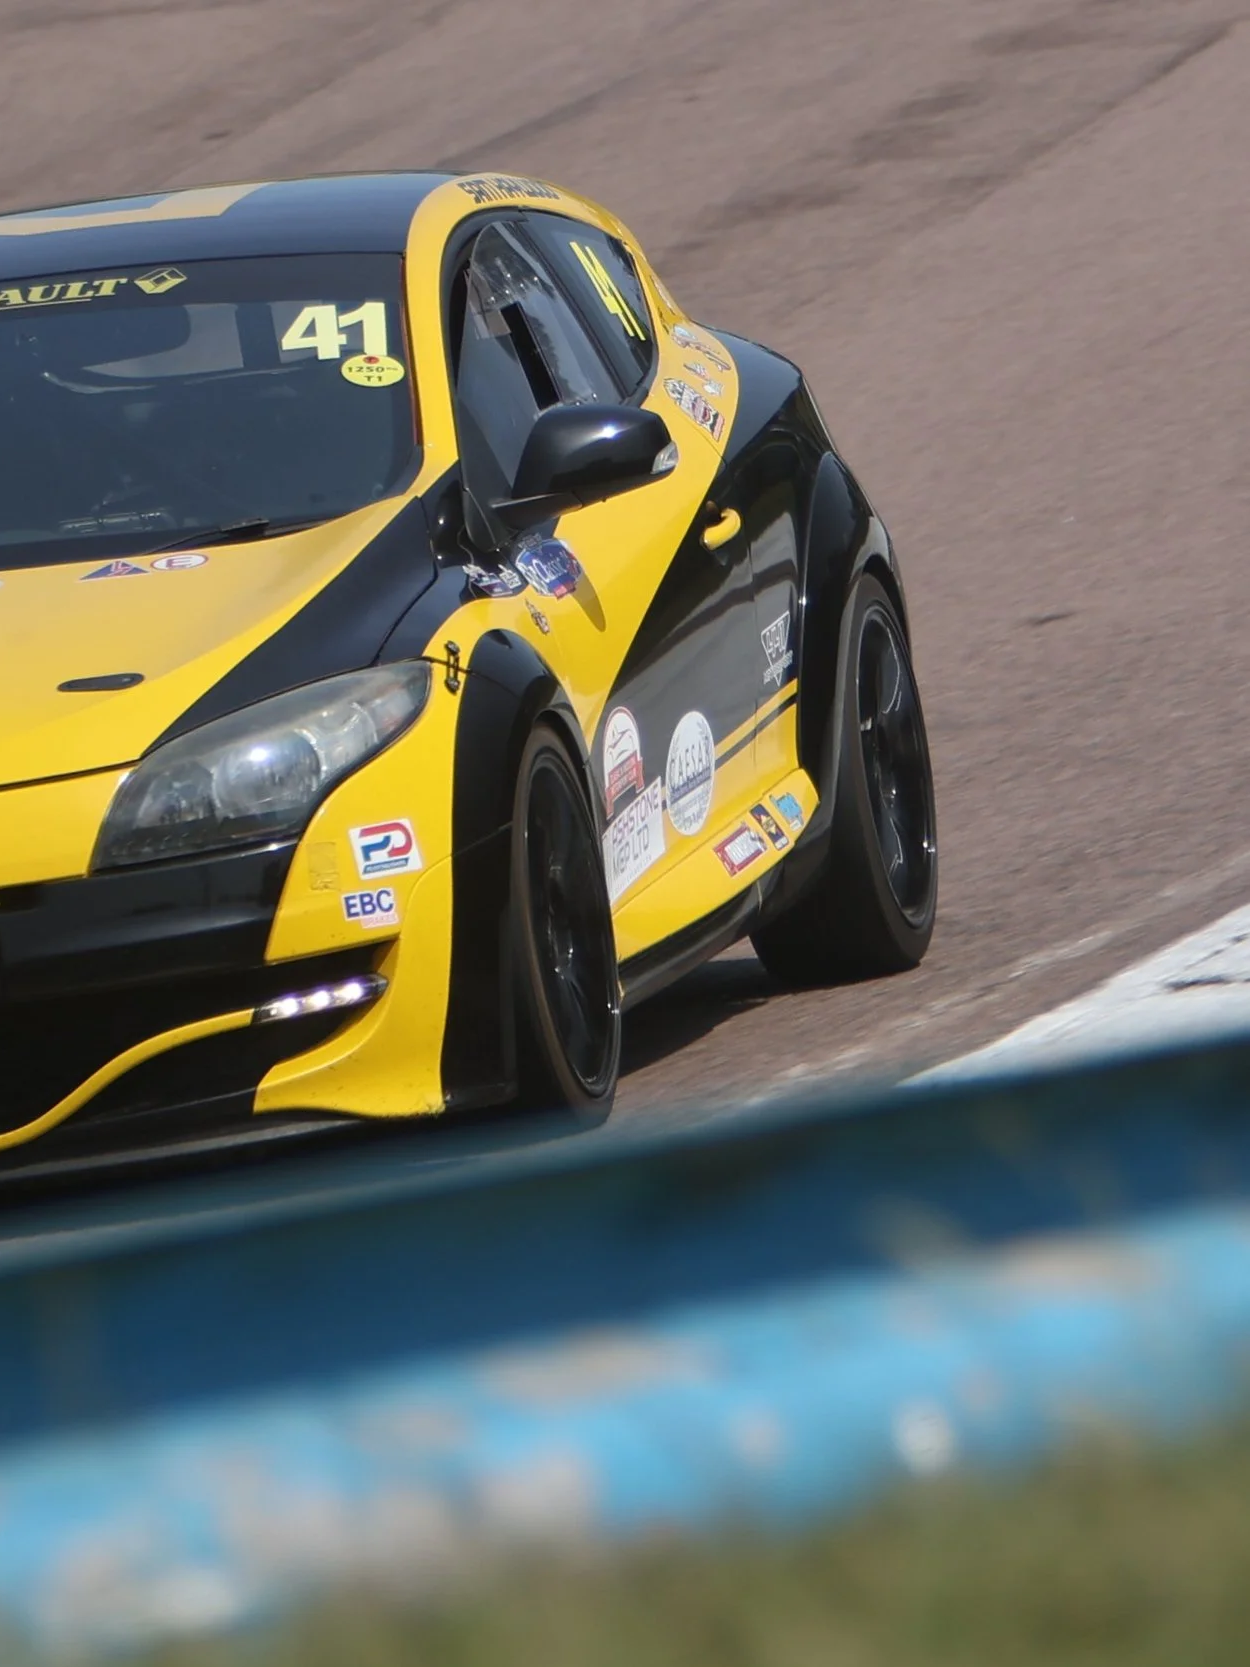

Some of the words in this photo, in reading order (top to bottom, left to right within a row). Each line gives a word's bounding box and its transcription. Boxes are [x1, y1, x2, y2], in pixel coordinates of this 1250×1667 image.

[281, 301, 387, 360] 41
[363, 375, 383, 383] T1
[343, 889, 395, 919] EBC
